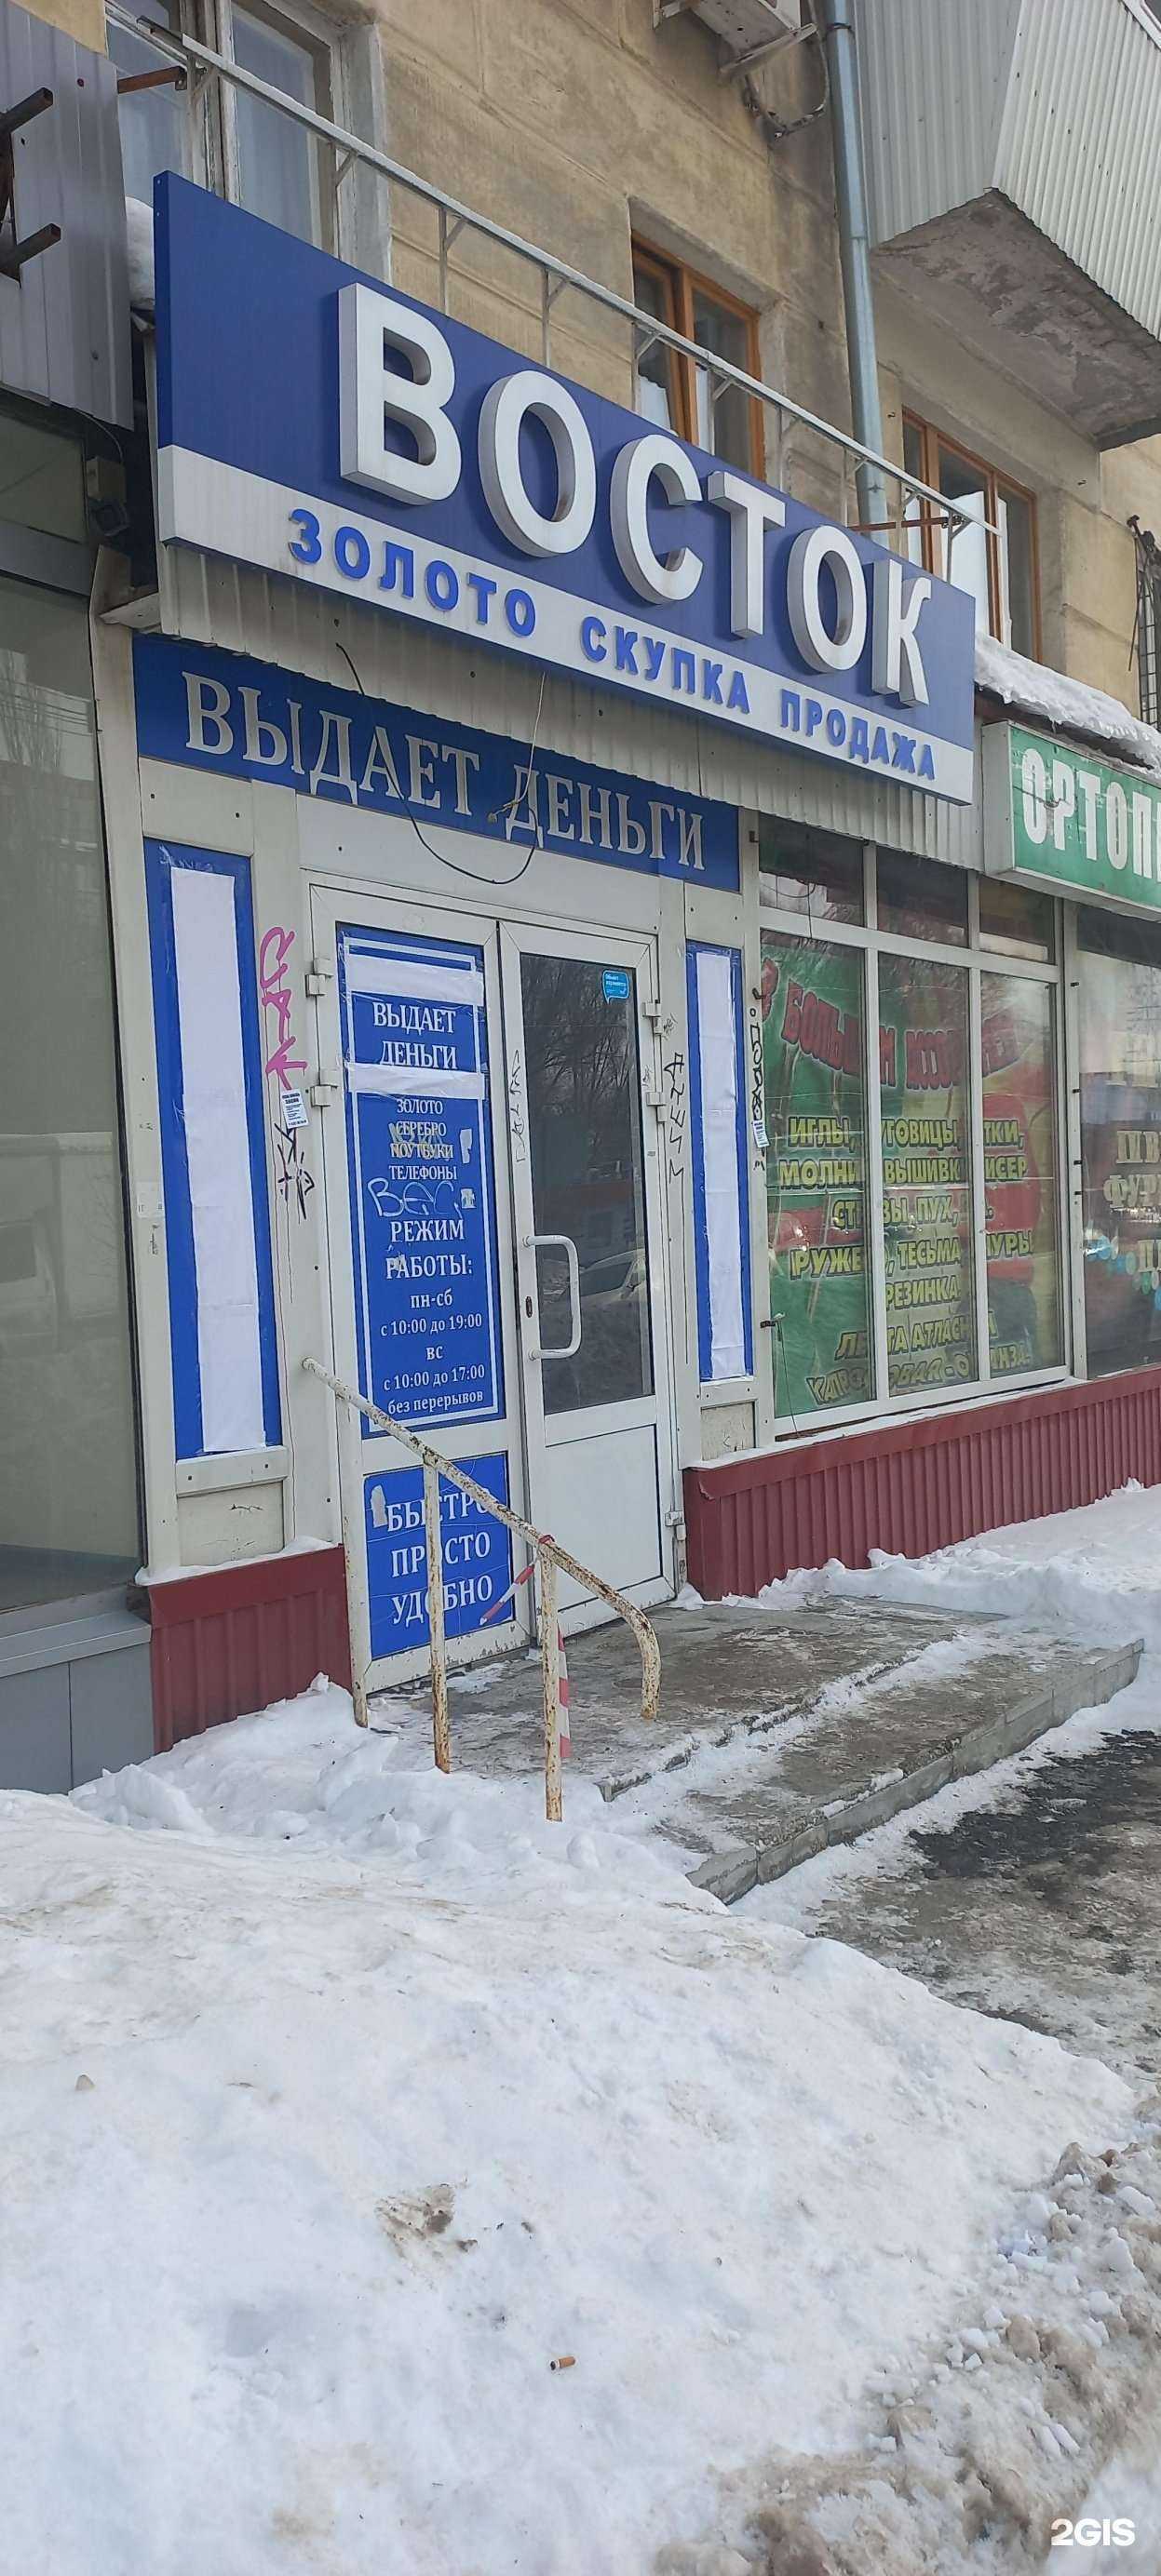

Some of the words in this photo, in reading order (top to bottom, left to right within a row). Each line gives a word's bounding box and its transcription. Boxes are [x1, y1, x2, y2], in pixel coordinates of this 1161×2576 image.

[338, 282, 931, 708] ВОСТОК
[289, 508, 537, 638] ЗОЛОТО
[582, 615, 751, 714] СКУПКА
[780, 690, 937, 781] ПРОДАЖА
[182, 671, 480, 816] ВЫДАЕТ
[506, 764, 706, 870] ДЕНЬГИ
[1021, 748, 1161, 883] ОРТОП
[372, 1001, 456, 1036] ВЫДАЕТ
[380, 1040, 457, 1069] ДЕНЬГИ
[397, 1098, 443, 1115] ЗОЛОТО
[396, 1120, 447, 1136] СЕРЕБРО
[983, 1120, 1024, 1149] ТКИ,
[390, 1143, 454, 1159] НОУТБУКИ
[389, 1165, 457, 1181] ТЕЛЕФОНЫ
[884, 1158, 965, 1186] ВЫШИВК
[984, 1155, 1029, 1183] ИСЕР
[390, 1219, 466, 1242] РЕЖИМ
[385, 1254, 473, 1280] РАБОТЫ:
[411, 1288, 453, 1308] пн-сб
[381, 1324, 388, 1336] с
[391, 1318, 427, 1335] 10:00
[430, 1318, 446, 1335] до
[449, 1313, 482, 1330] 19:00
[384, 1377, 391, 1390] с
[394, 1373, 429, 1389] 10:00
[432, 1373, 449, 1386] до
[452, 1364, 485, 1383] 17:00
[387, 1400, 411, 1415] без
[413, 1390, 484, 1413] перерывов
[391, 1531, 492, 1577] ПРСТО
